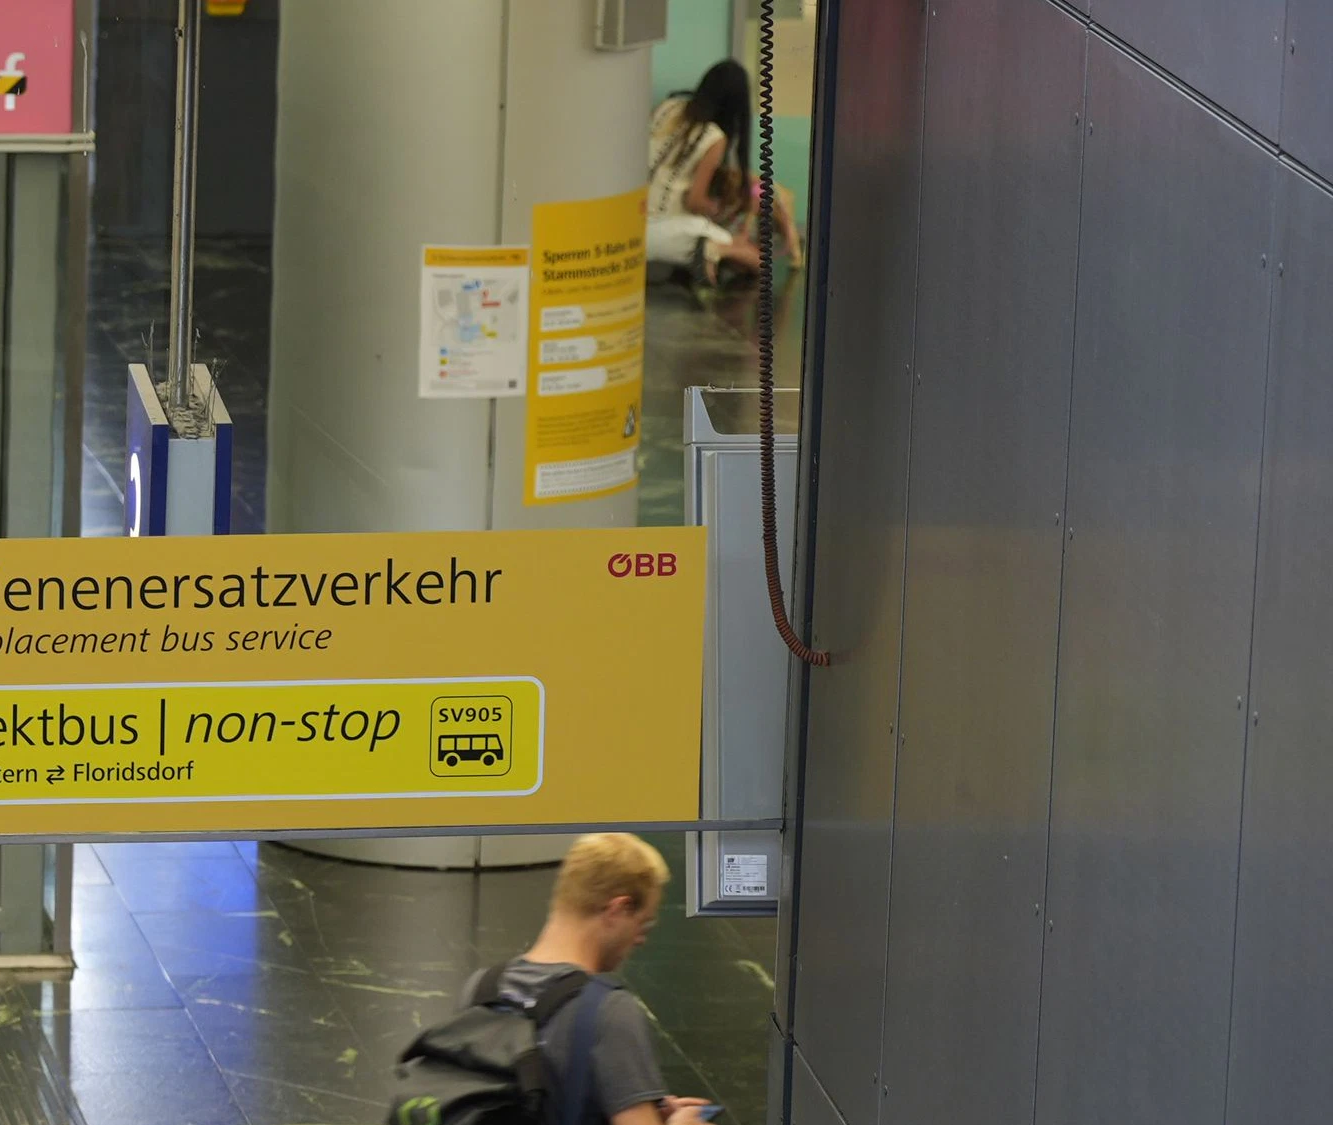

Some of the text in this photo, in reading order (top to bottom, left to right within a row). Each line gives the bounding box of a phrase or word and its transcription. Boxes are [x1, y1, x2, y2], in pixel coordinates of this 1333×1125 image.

[608, 552, 677, 578] ÖBB
[160, 624, 216, 653] bus
[225, 622, 333, 652] service
[438, 706, 502, 723] SV905
[184, 703, 401, 753] non-stop
[74, 760, 195, 782] Floridsdorf
